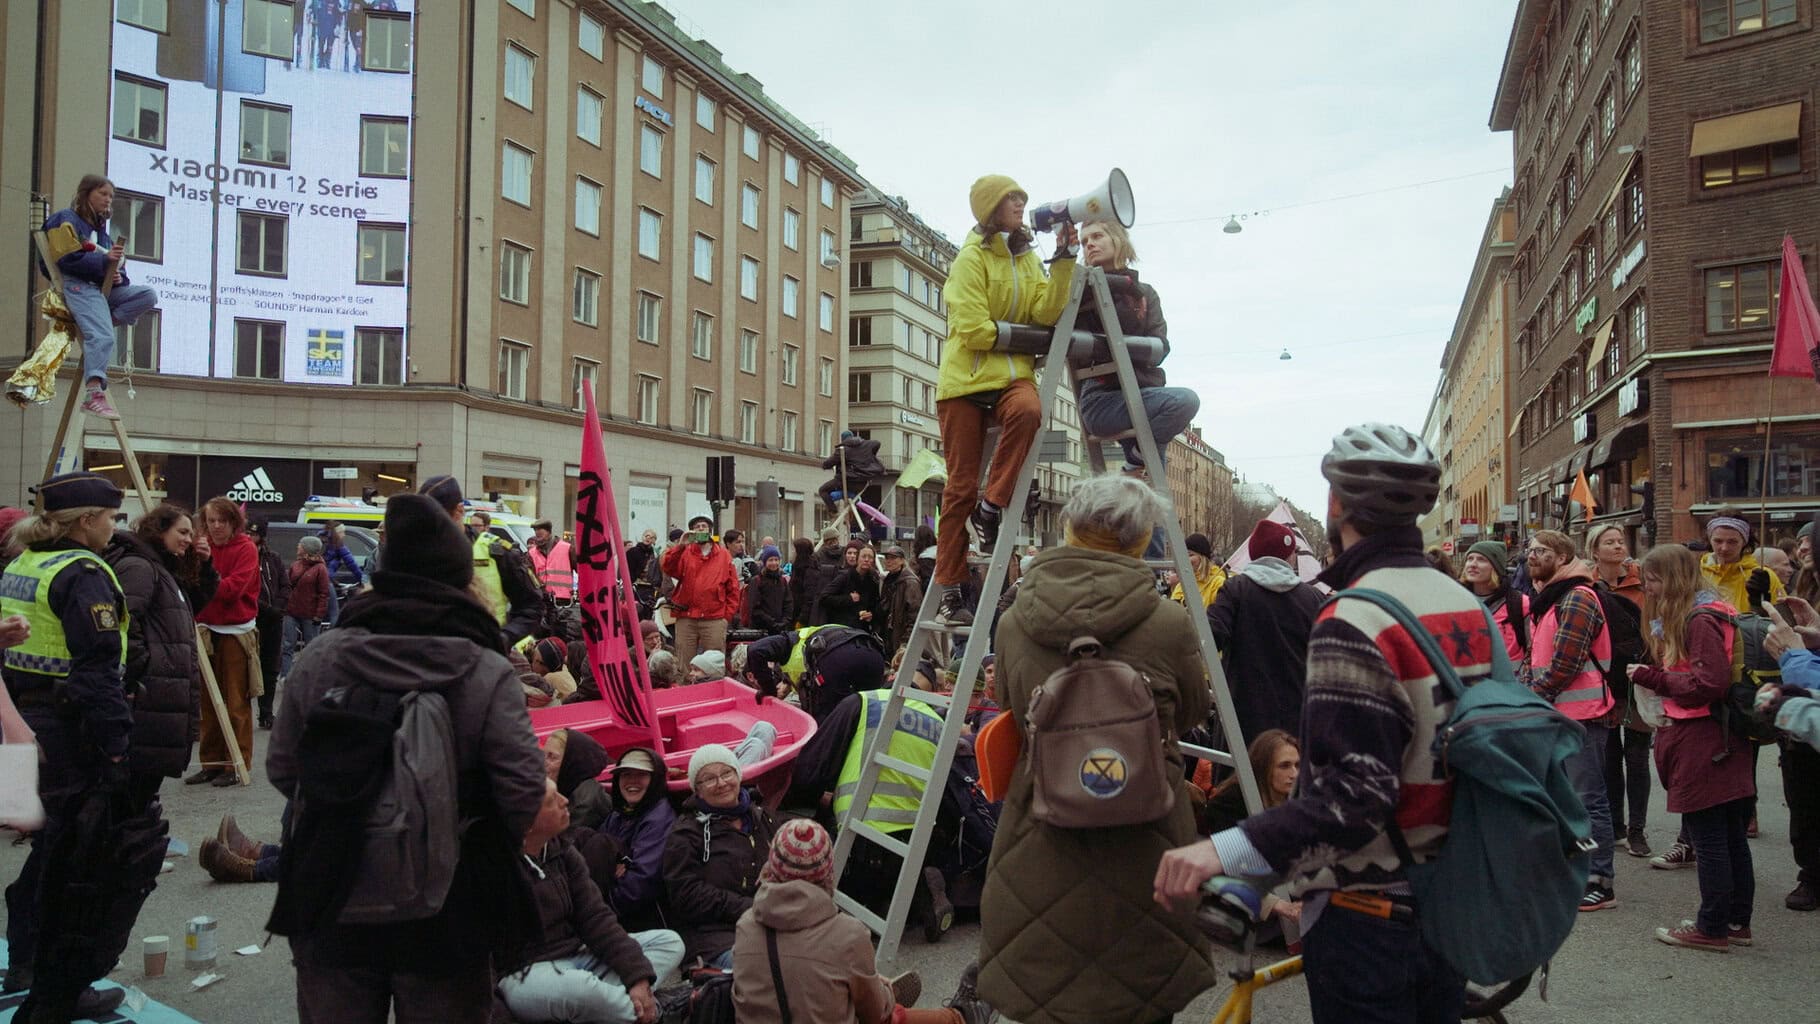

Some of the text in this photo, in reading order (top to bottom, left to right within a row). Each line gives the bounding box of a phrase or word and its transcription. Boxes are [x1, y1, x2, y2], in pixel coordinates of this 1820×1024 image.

[287, 176, 306, 194] 12
[255, 198, 304, 216] every
[226, 489, 284, 503] adidas
